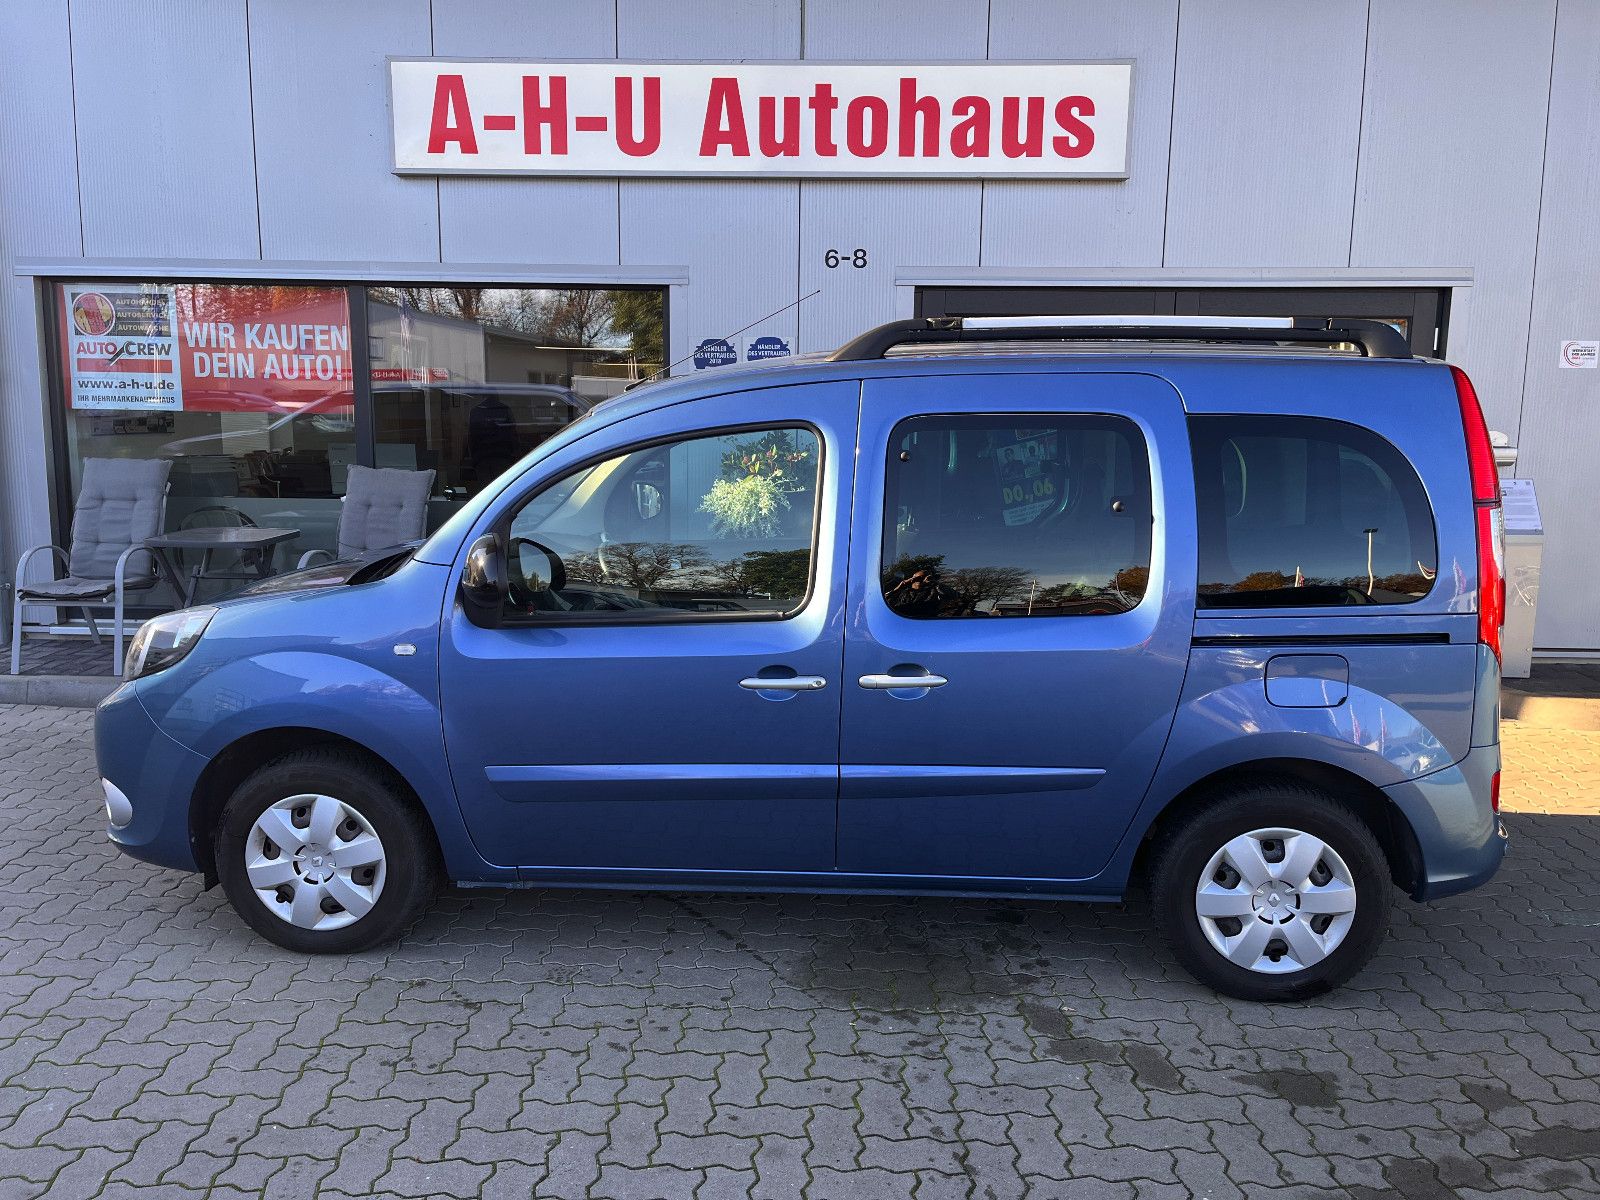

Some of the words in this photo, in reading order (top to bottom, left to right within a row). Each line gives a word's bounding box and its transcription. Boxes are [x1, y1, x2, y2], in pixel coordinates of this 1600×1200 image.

[427, 74, 662, 157] A-H-U
[699, 77, 1096, 159] Autohaus
[825, 248, 868, 269] 6-8
[183, 322, 236, 349] WIR
[244, 323, 347, 351] KAUFEN
[77, 342, 117, 355] AUTO
[124, 341, 172, 356] CREW
[193, 352, 255, 379] DEIN
[263, 353, 343, 381] AUTO!
[77, 379, 175, 390] www.a-h-u.de
[77, 394, 89, 402] IHR
